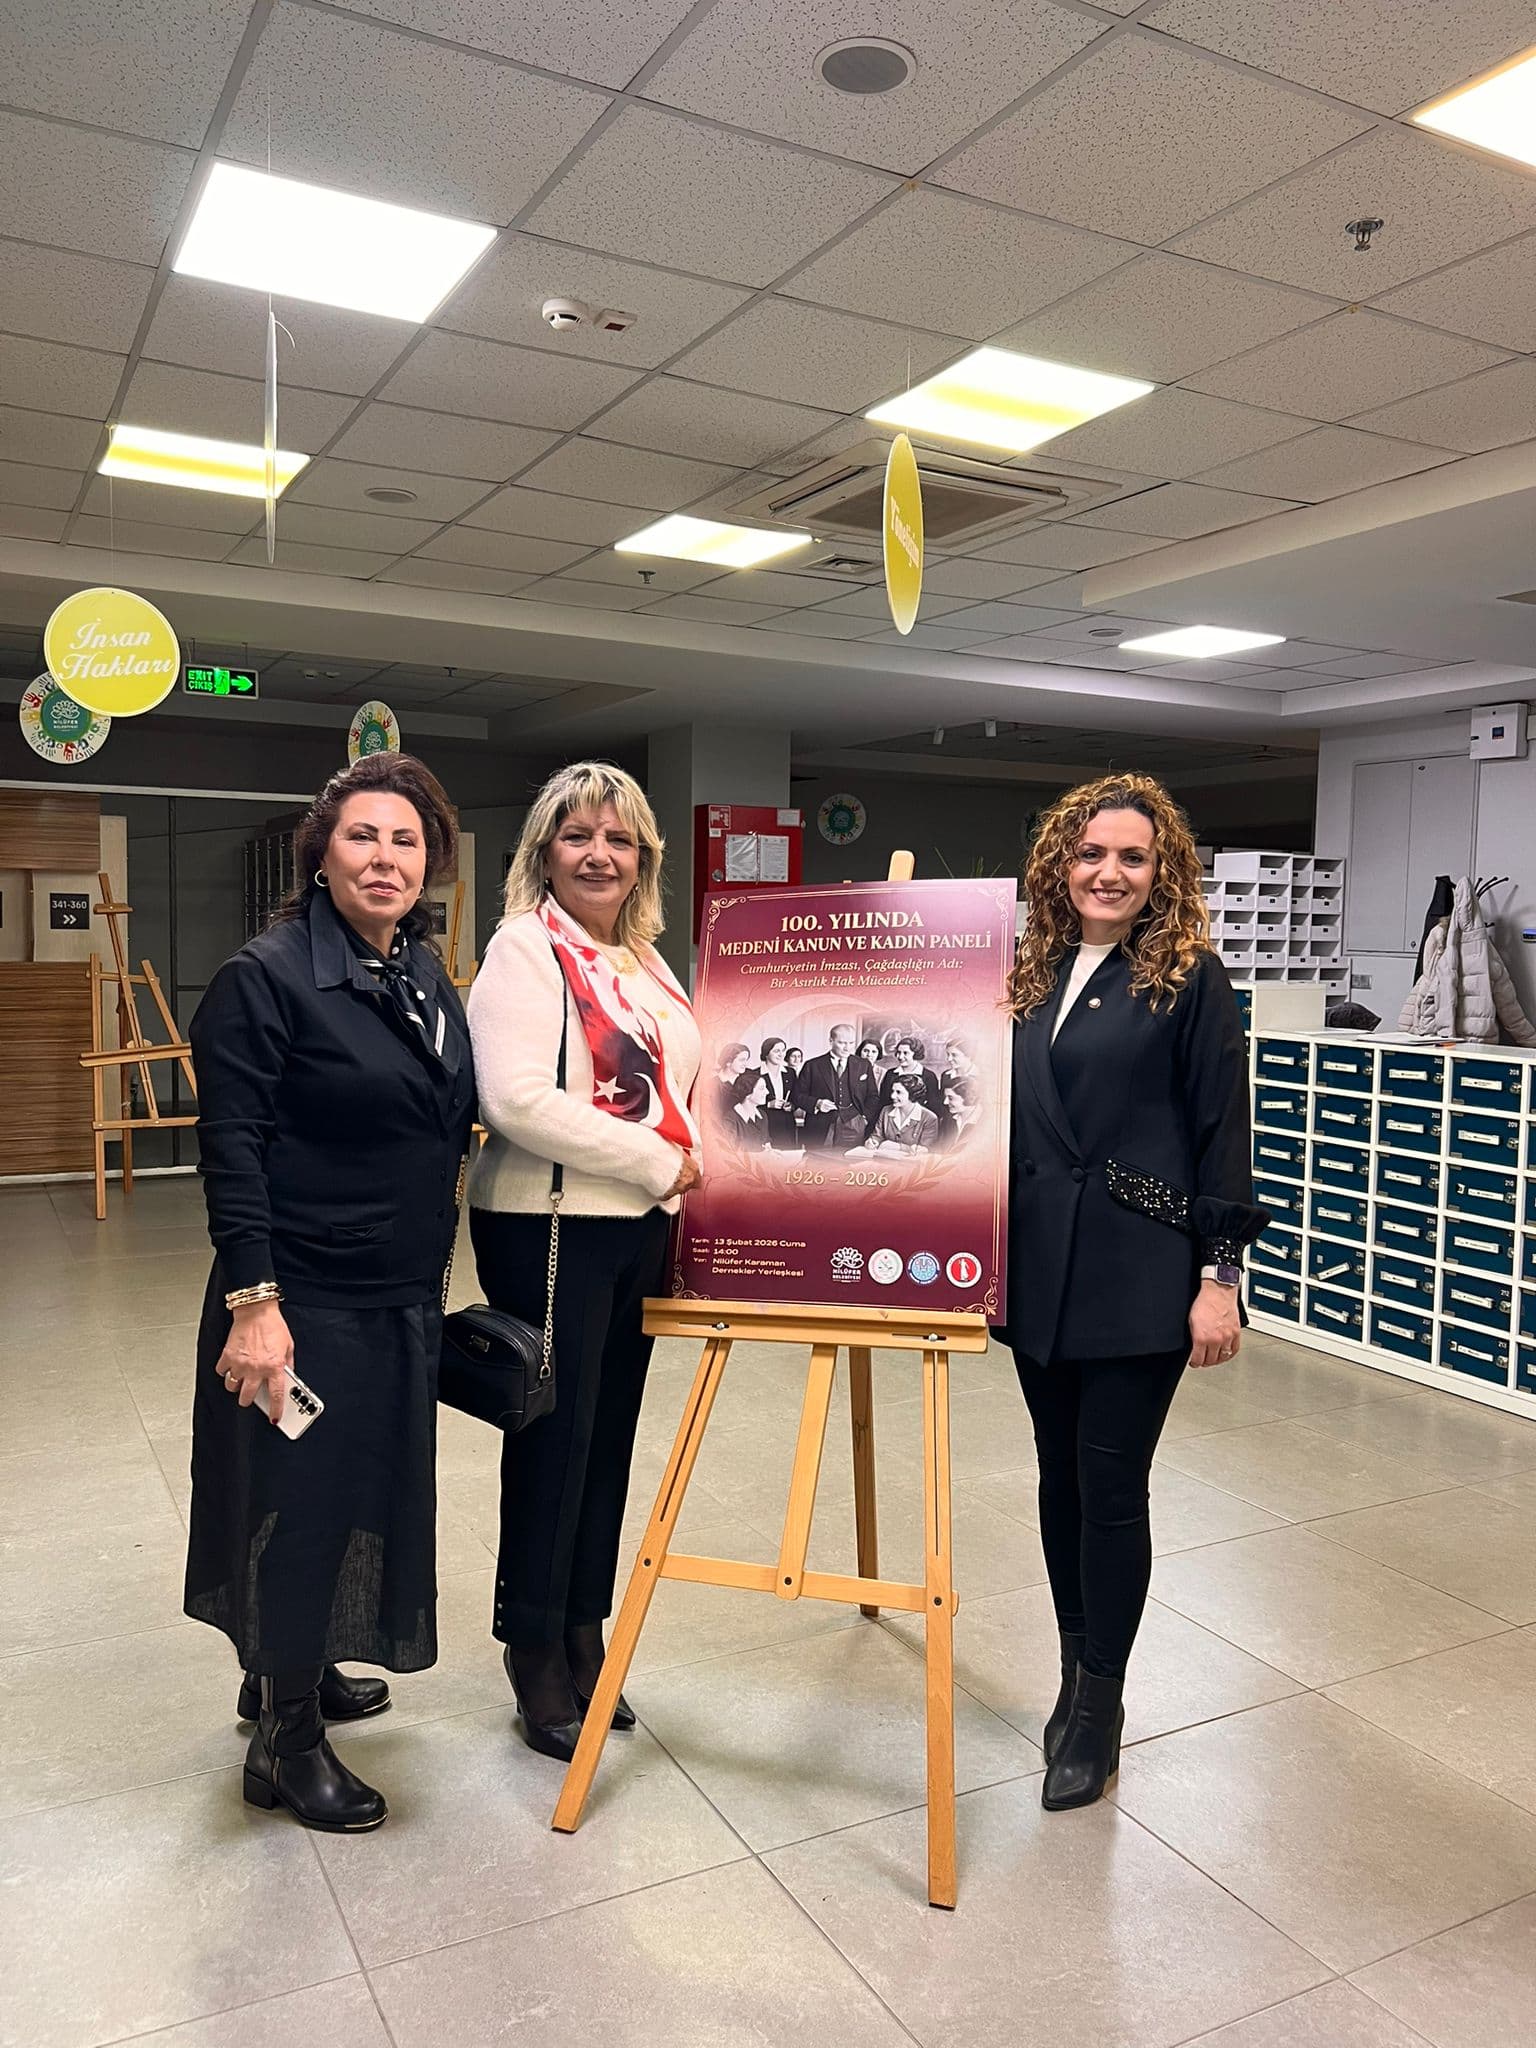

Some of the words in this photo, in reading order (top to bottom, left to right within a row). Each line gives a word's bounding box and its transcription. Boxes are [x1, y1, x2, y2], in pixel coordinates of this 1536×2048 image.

[70, 618, 152, 650] İnsan
[59, 653, 174, 681] Hakları
[188, 670, 213, 681] EXIT
[52, 900, 87, 909] 341-360
[781, 915, 823, 933] 100.
[828, 911, 924, 930] YILINDA
[718, 936, 780, 957] MEDENİ
[783, 936, 841, 954] KANUN
[845, 935, 868, 951] VE
[870, 933, 925, 951] KADIN
[929, 930, 992, 949] PANELİ
[740, 961, 817, 977] Cumhuriyetin
[819, 957, 862, 973] İmzası,
[864, 956, 935, 975] Çağdaşlığın
[937, 957, 964, 970] Adı:
[770, 977, 788, 989] Bir
[790, 975, 828, 988] Asırlık
[830, 974, 855, 987] Hak
[857, 972, 928, 987] Mücadelesi.
[785, 1169, 824, 1186] 1926
[845, 1170, 888, 1188] 2026
[714, 1238, 725, 1246] 13
[727, 1238, 753, 1247] Şubat
[780, 1240, 806, 1248] Cuma
[712, 1266, 756, 1275] Dernekler
[758, 1268, 804, 1277] Yerleşkesi
[713, 1258, 743, 1266] Nilüfer
[745, 1258, 785, 1267] Karaman
